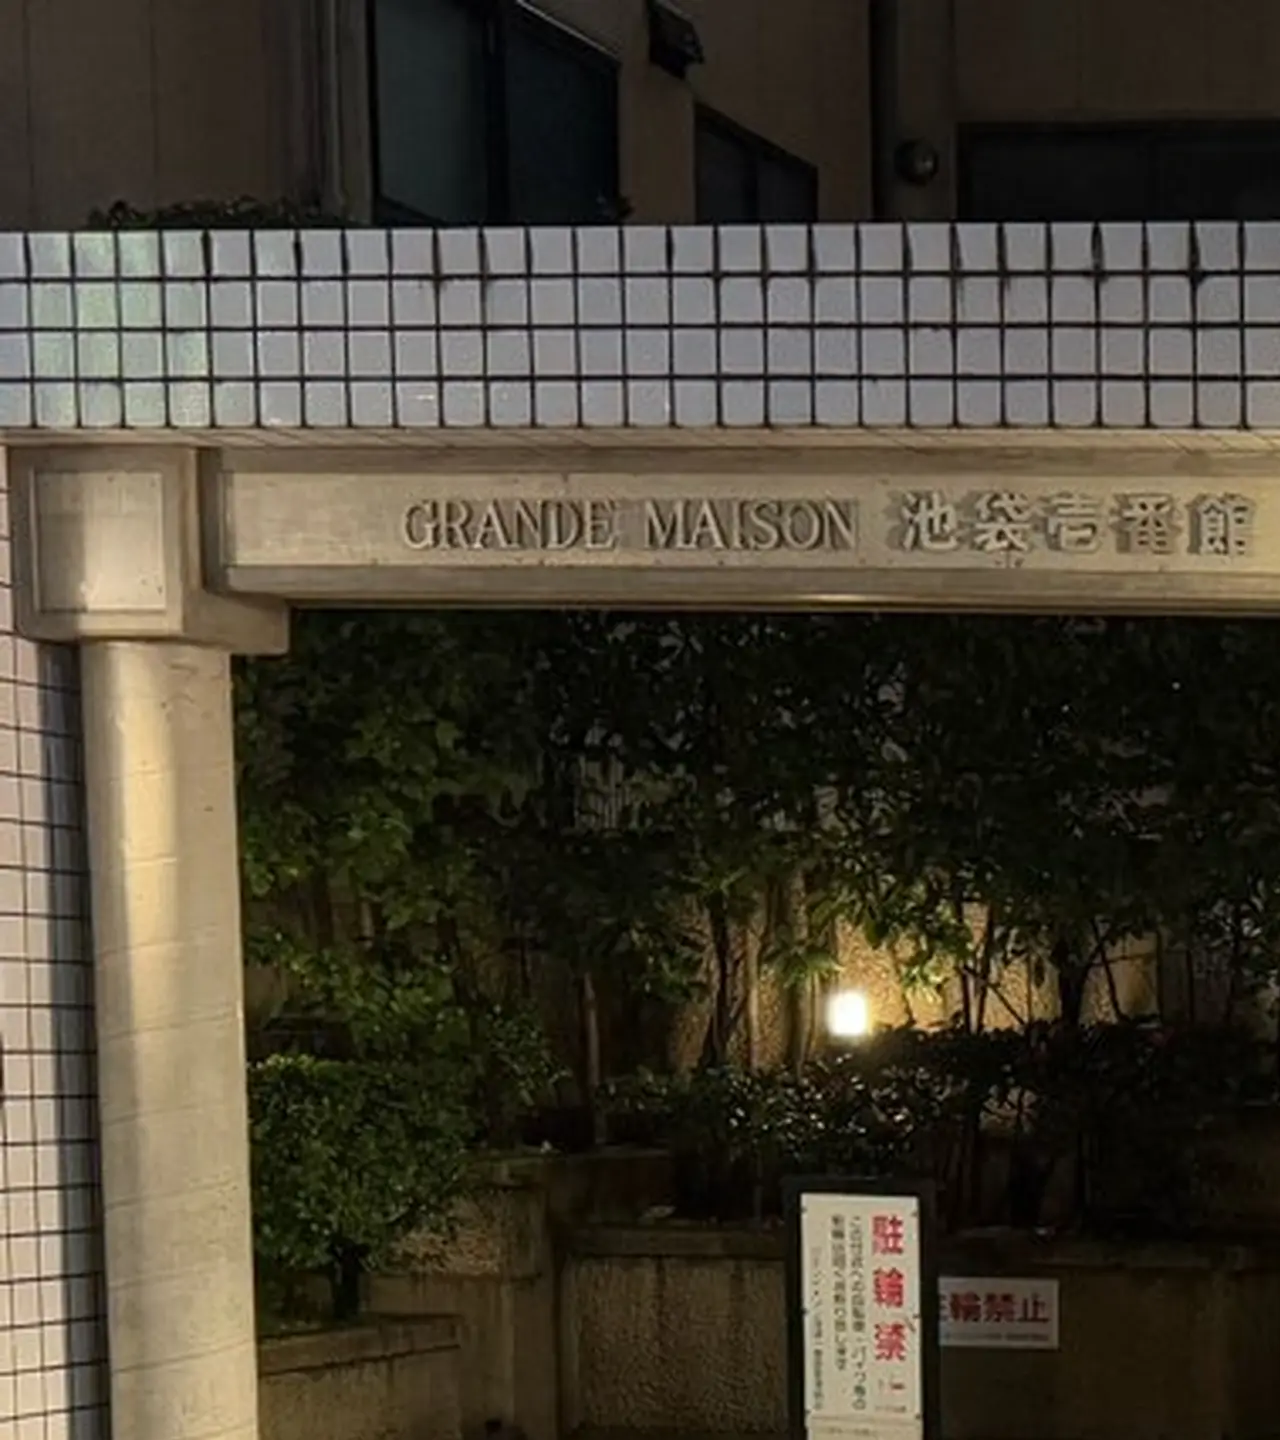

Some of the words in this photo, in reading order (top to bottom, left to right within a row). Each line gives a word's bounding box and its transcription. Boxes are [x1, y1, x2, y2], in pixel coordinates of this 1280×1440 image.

[404, 498, 617, 550] GRANDE
[643, 498, 858, 550] MAISON
[872, 1214, 907, 1392] 駐輪禁
